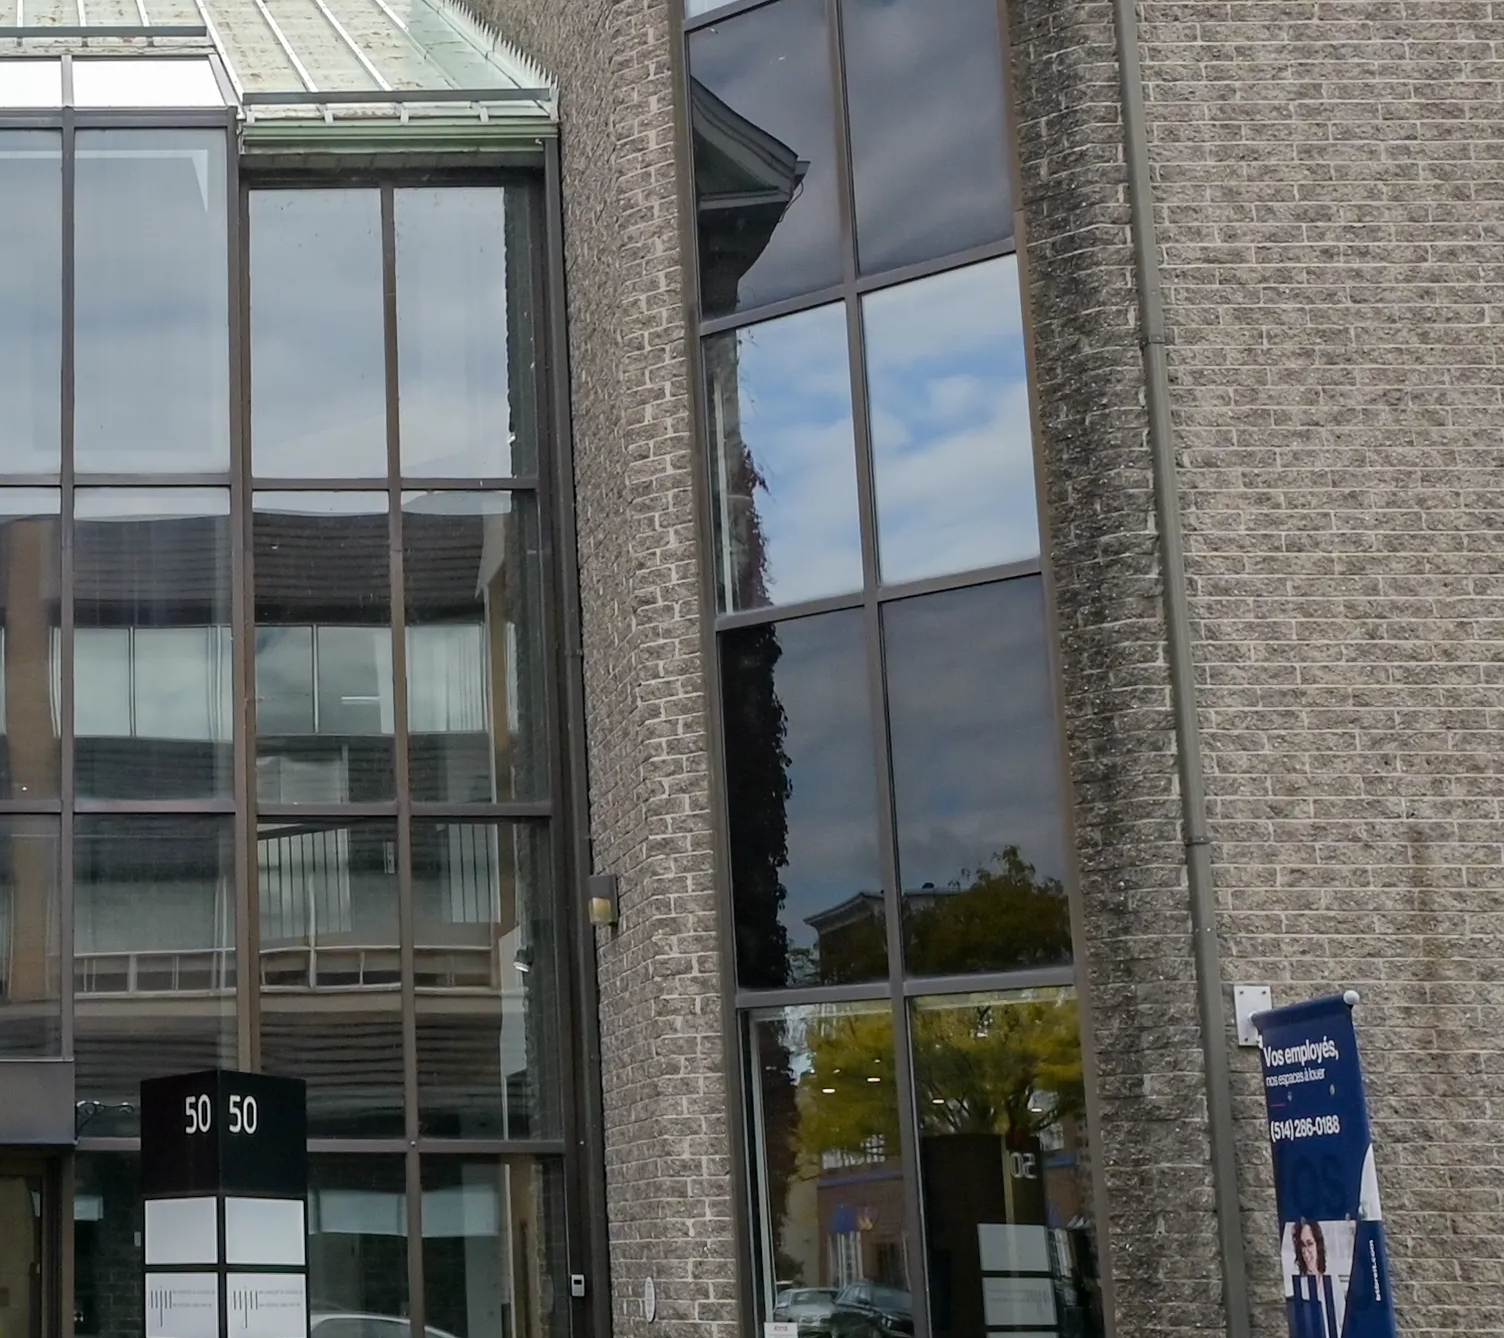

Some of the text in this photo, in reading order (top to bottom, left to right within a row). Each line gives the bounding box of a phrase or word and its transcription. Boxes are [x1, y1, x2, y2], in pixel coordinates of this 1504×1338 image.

[1263, 1035, 1340, 1067] Vos employés,
[1265, 1075, 1278, 1087] nos
[1278, 1069, 1304, 1087] espaces
[1309, 1067, 1326, 1081] louer
[185, 1093, 212, 1135] 50
[229, 1094, 257, 1135] 50
[1271, 1115, 1340, 1143] (514) 286-0188
